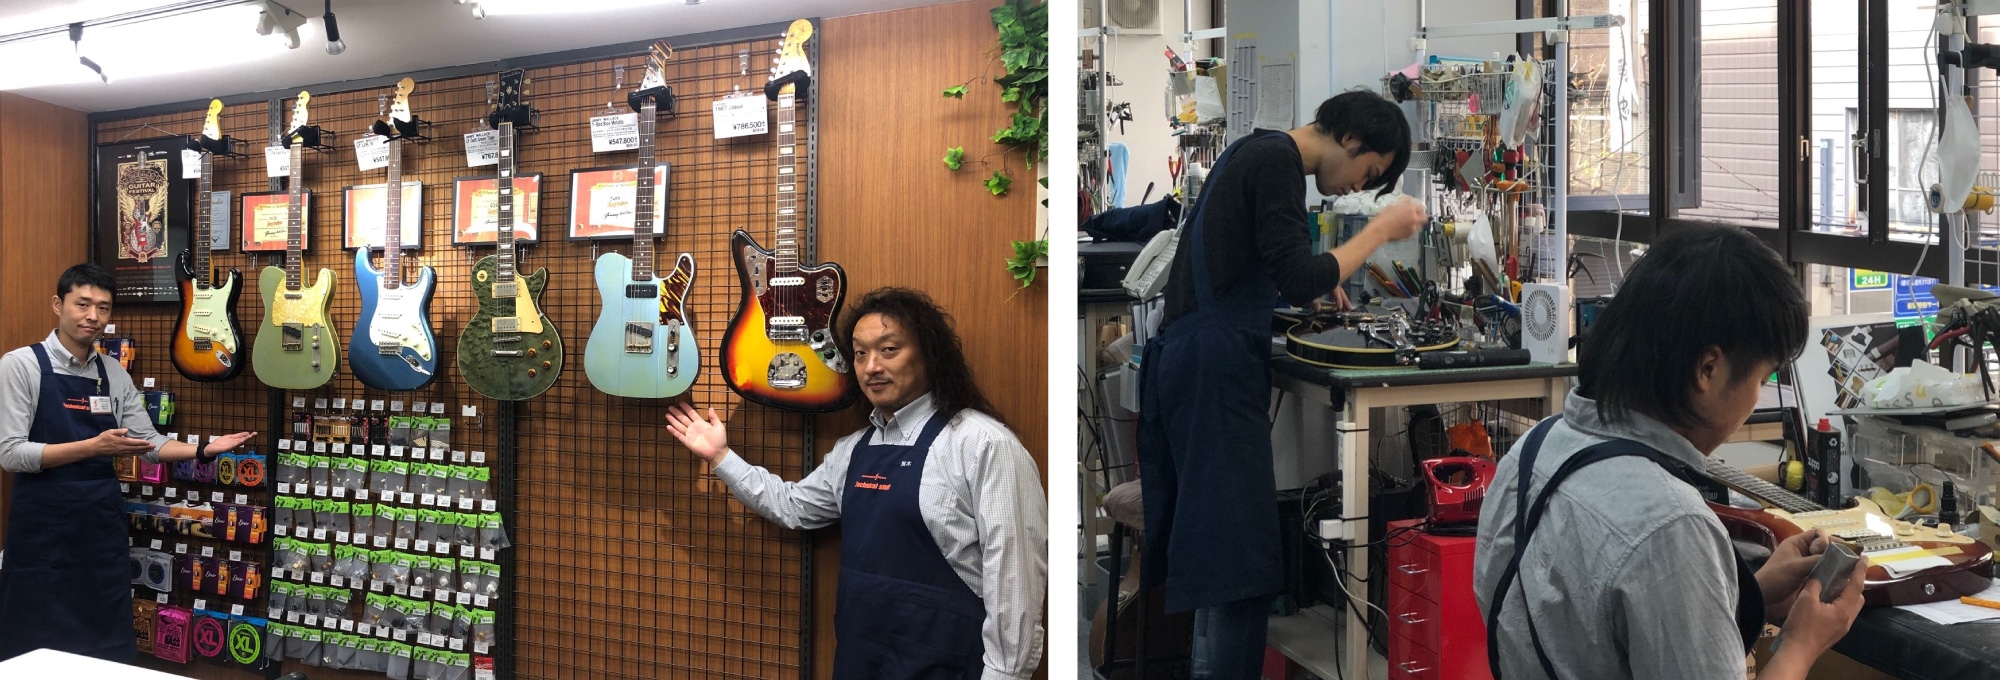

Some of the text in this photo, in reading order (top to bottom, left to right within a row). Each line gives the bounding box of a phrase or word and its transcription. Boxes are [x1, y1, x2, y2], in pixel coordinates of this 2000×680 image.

[128, 182, 156, 190] GUITAR
[1861, 275, 1881, 285] 24H
[222, 465, 231, 476] XL
[242, 466, 257, 477] XL
[199, 628, 218, 647] XL
[235, 634, 254, 654] XL
